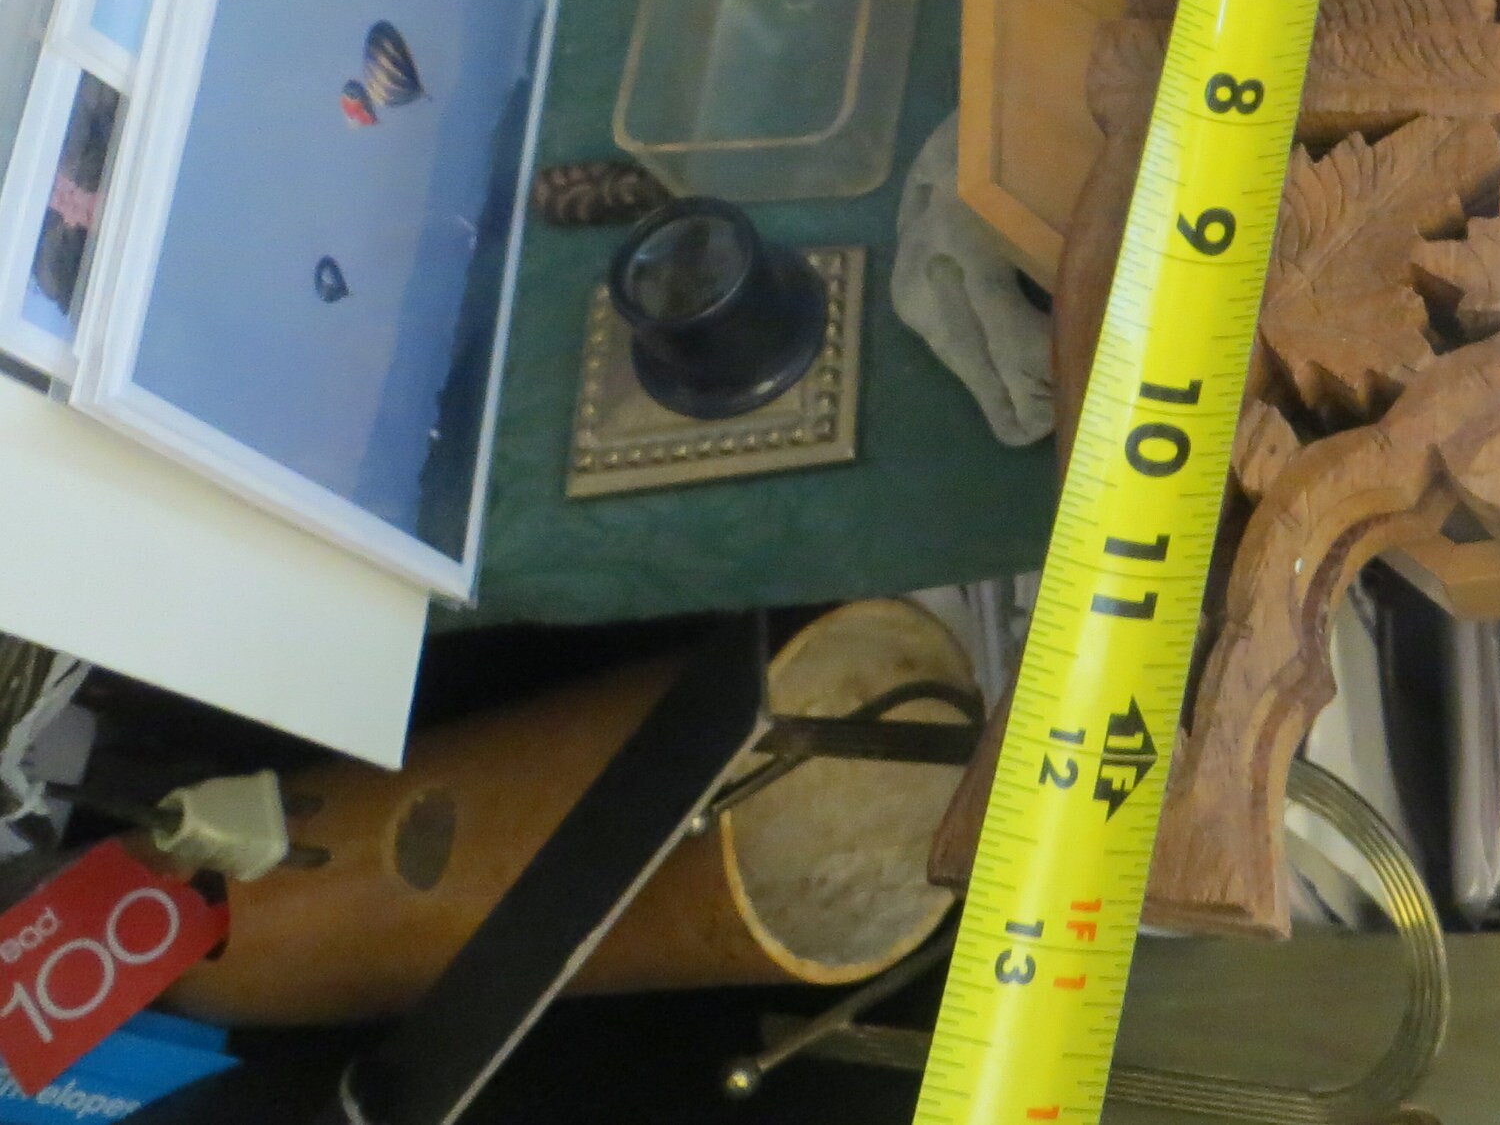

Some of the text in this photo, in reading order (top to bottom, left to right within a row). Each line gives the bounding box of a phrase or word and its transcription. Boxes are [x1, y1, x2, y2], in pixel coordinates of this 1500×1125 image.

[1205, 72, 1265, 115] 8
[1176, 207, 1237, 257] 9
[1124, 379, 1203, 477] 10
[1090, 534, 1171, 621] 11
[1038, 726, 1086, 791] 12
[1099, 729, 1145, 796] 1F
[994, 918, 1046, 987] 13
[1066, 898, 1103, 943] 1F
[0, 887, 181, 1044] 100
